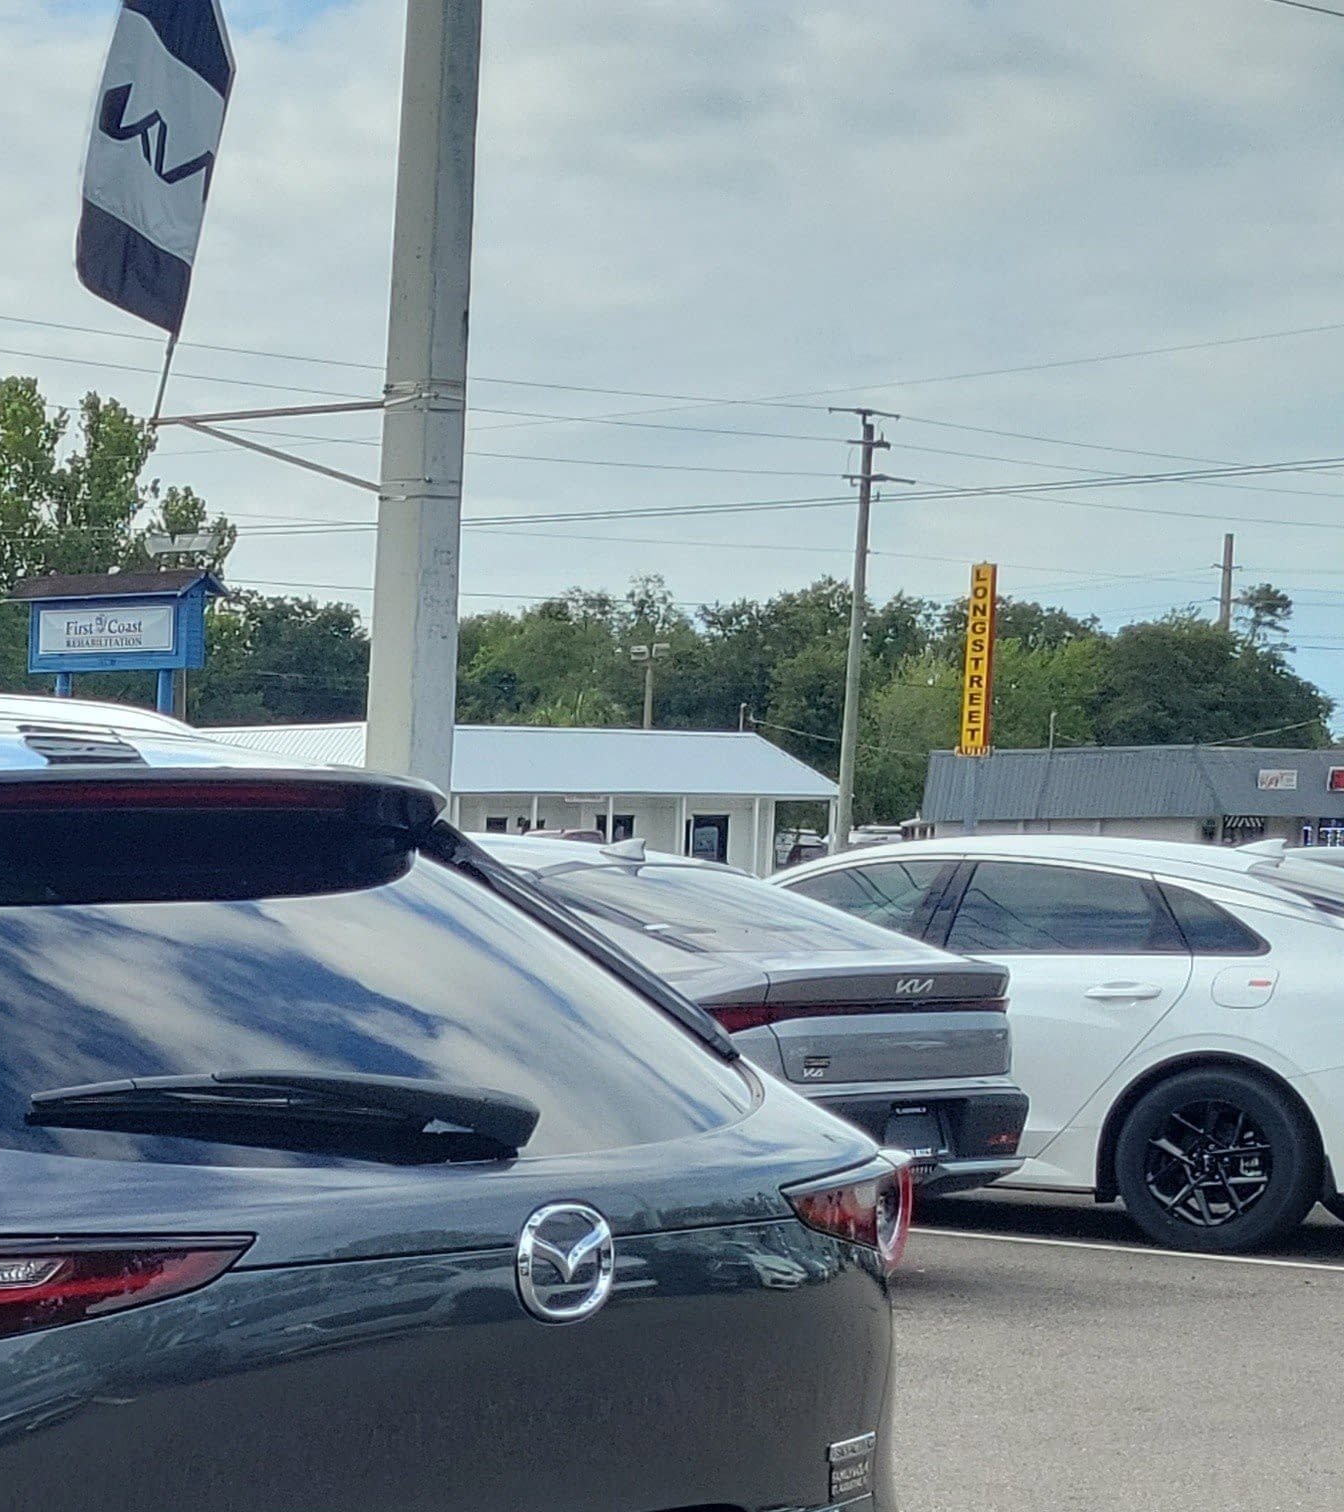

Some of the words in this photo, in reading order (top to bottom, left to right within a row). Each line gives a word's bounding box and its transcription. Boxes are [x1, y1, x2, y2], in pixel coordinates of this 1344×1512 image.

[65, 621, 93, 635] First
[107, 619, 143, 634] Coast
[66, 637, 142, 648] REHABILITATION
[967, 569, 988, 741] LONGSTREET
